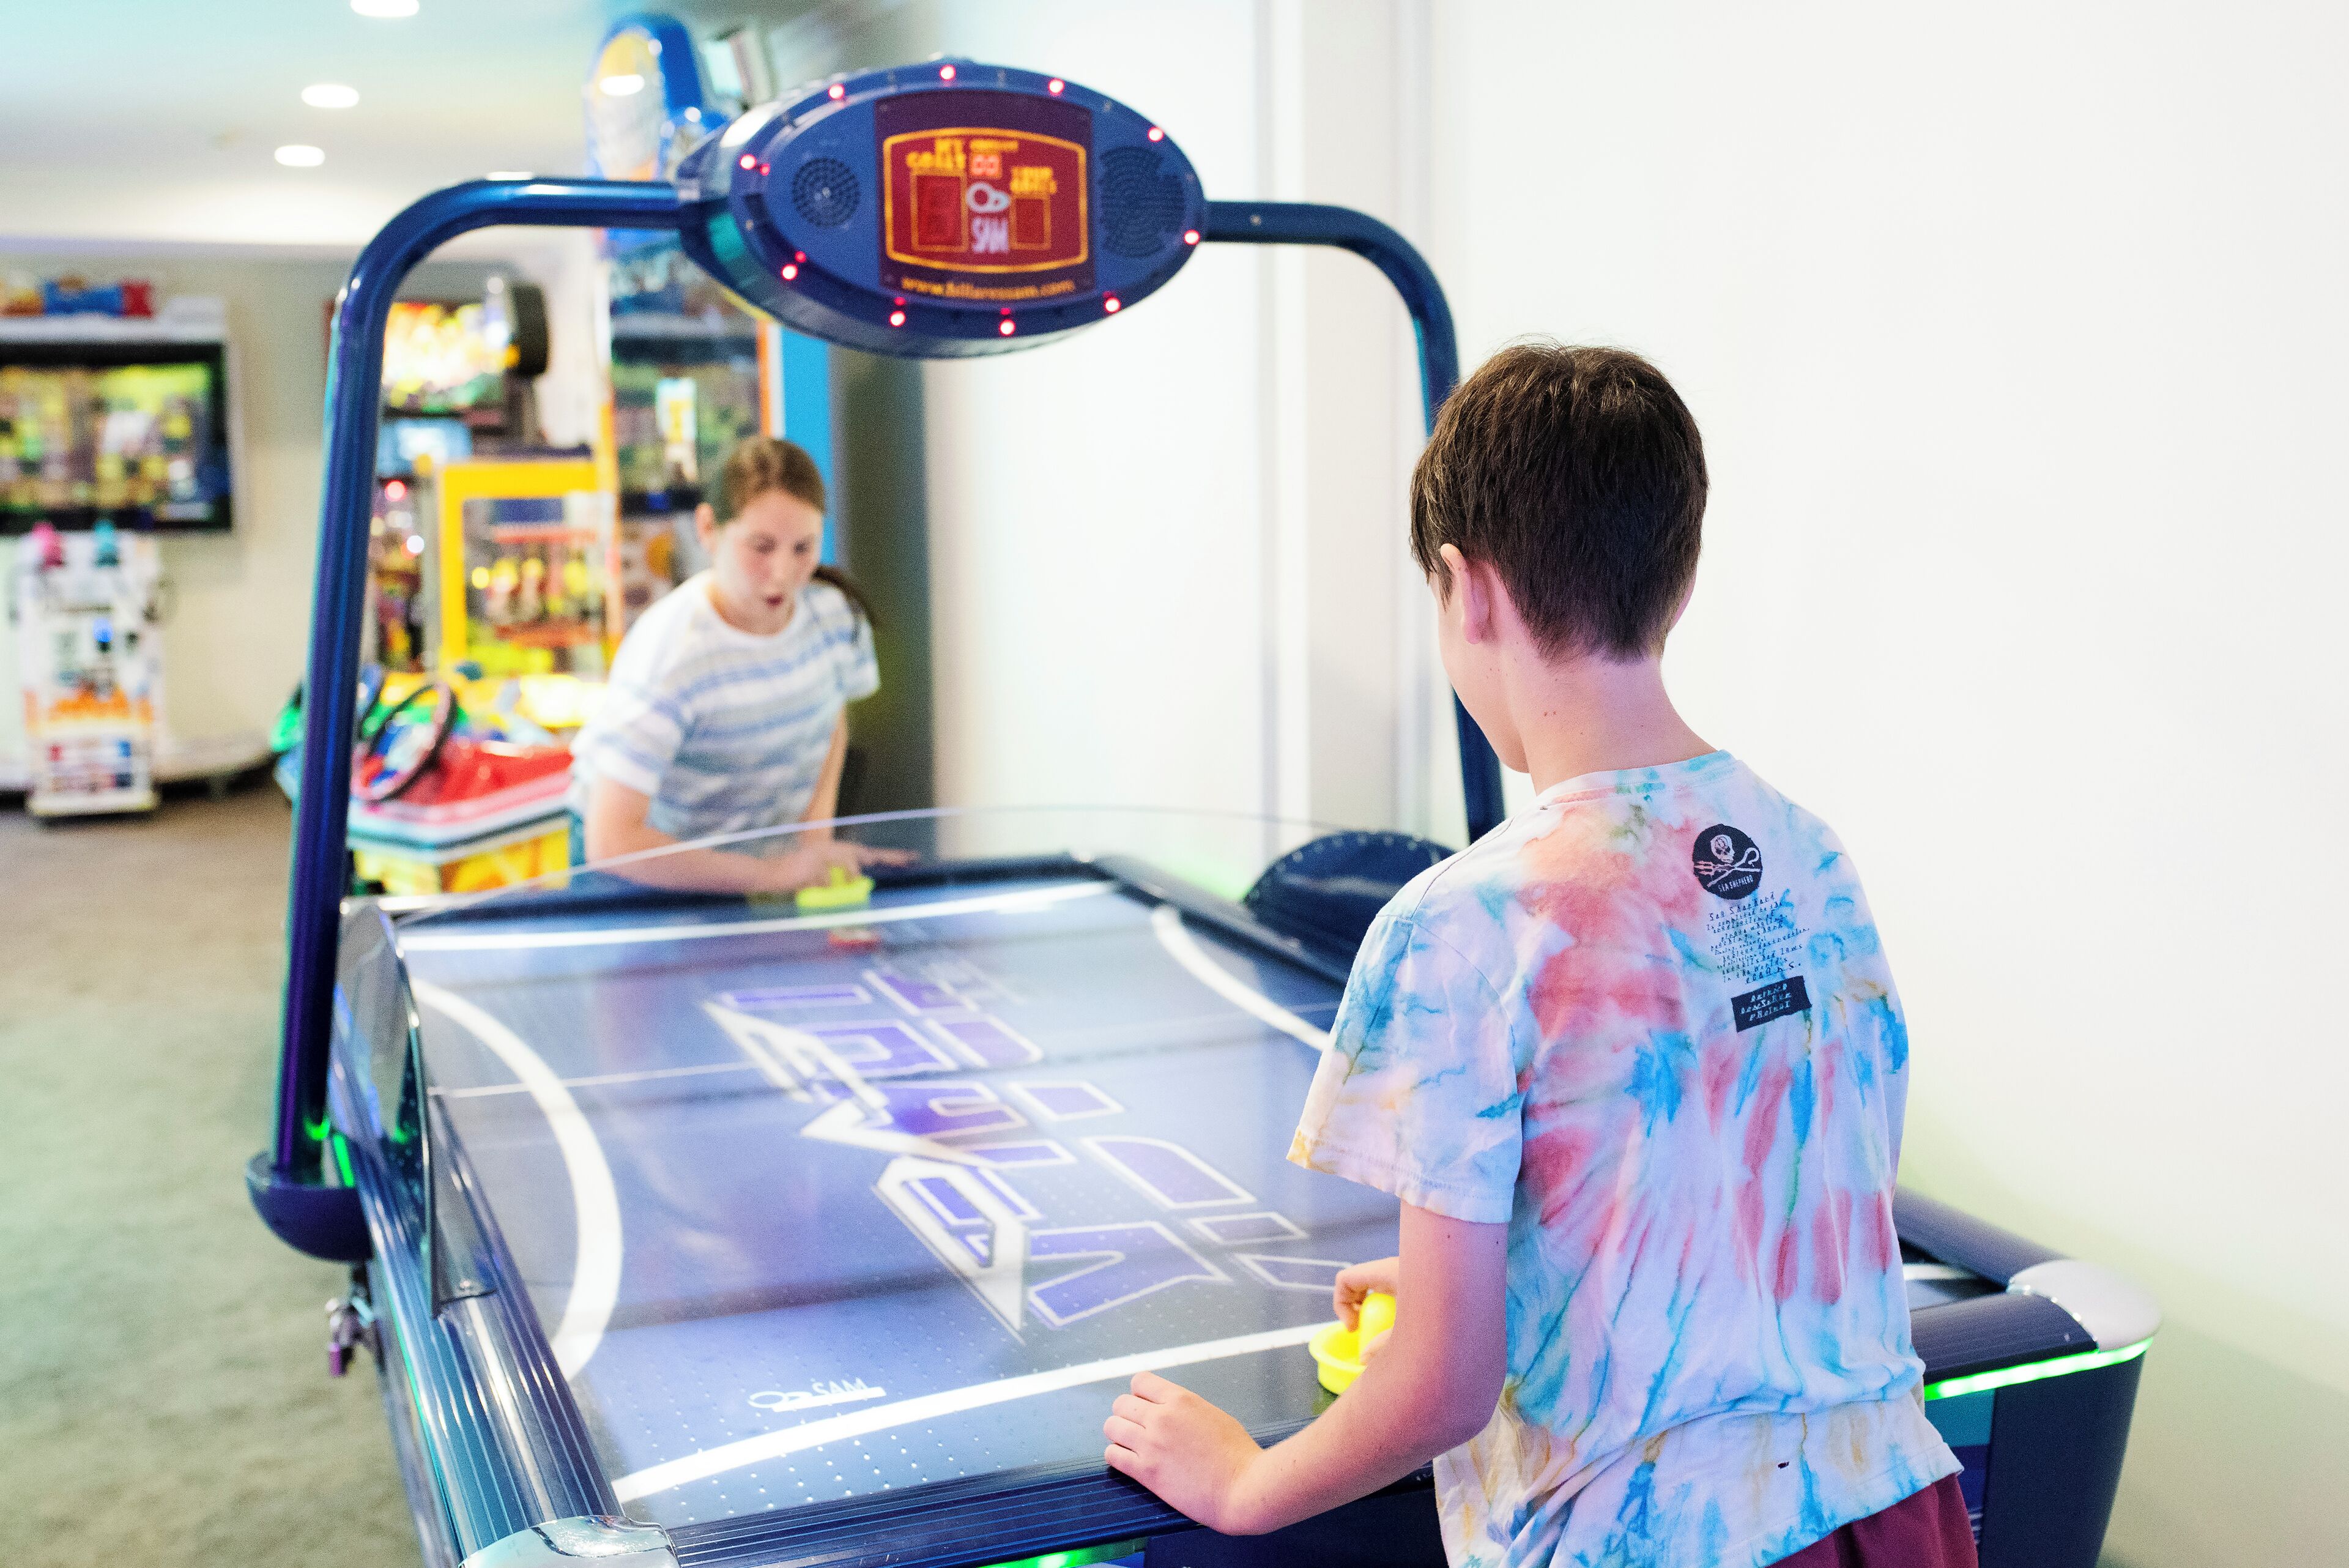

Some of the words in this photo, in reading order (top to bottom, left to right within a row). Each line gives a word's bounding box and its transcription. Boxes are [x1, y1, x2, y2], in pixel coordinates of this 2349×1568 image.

[1718, 881, 1729, 893] SEA
[1729, 874, 1754, 890] SHEPHERD
[1709, 910, 1724, 921] Sea
[1781, 945, 1802, 955] laws
[812, 1377, 869, 1395] SAM
